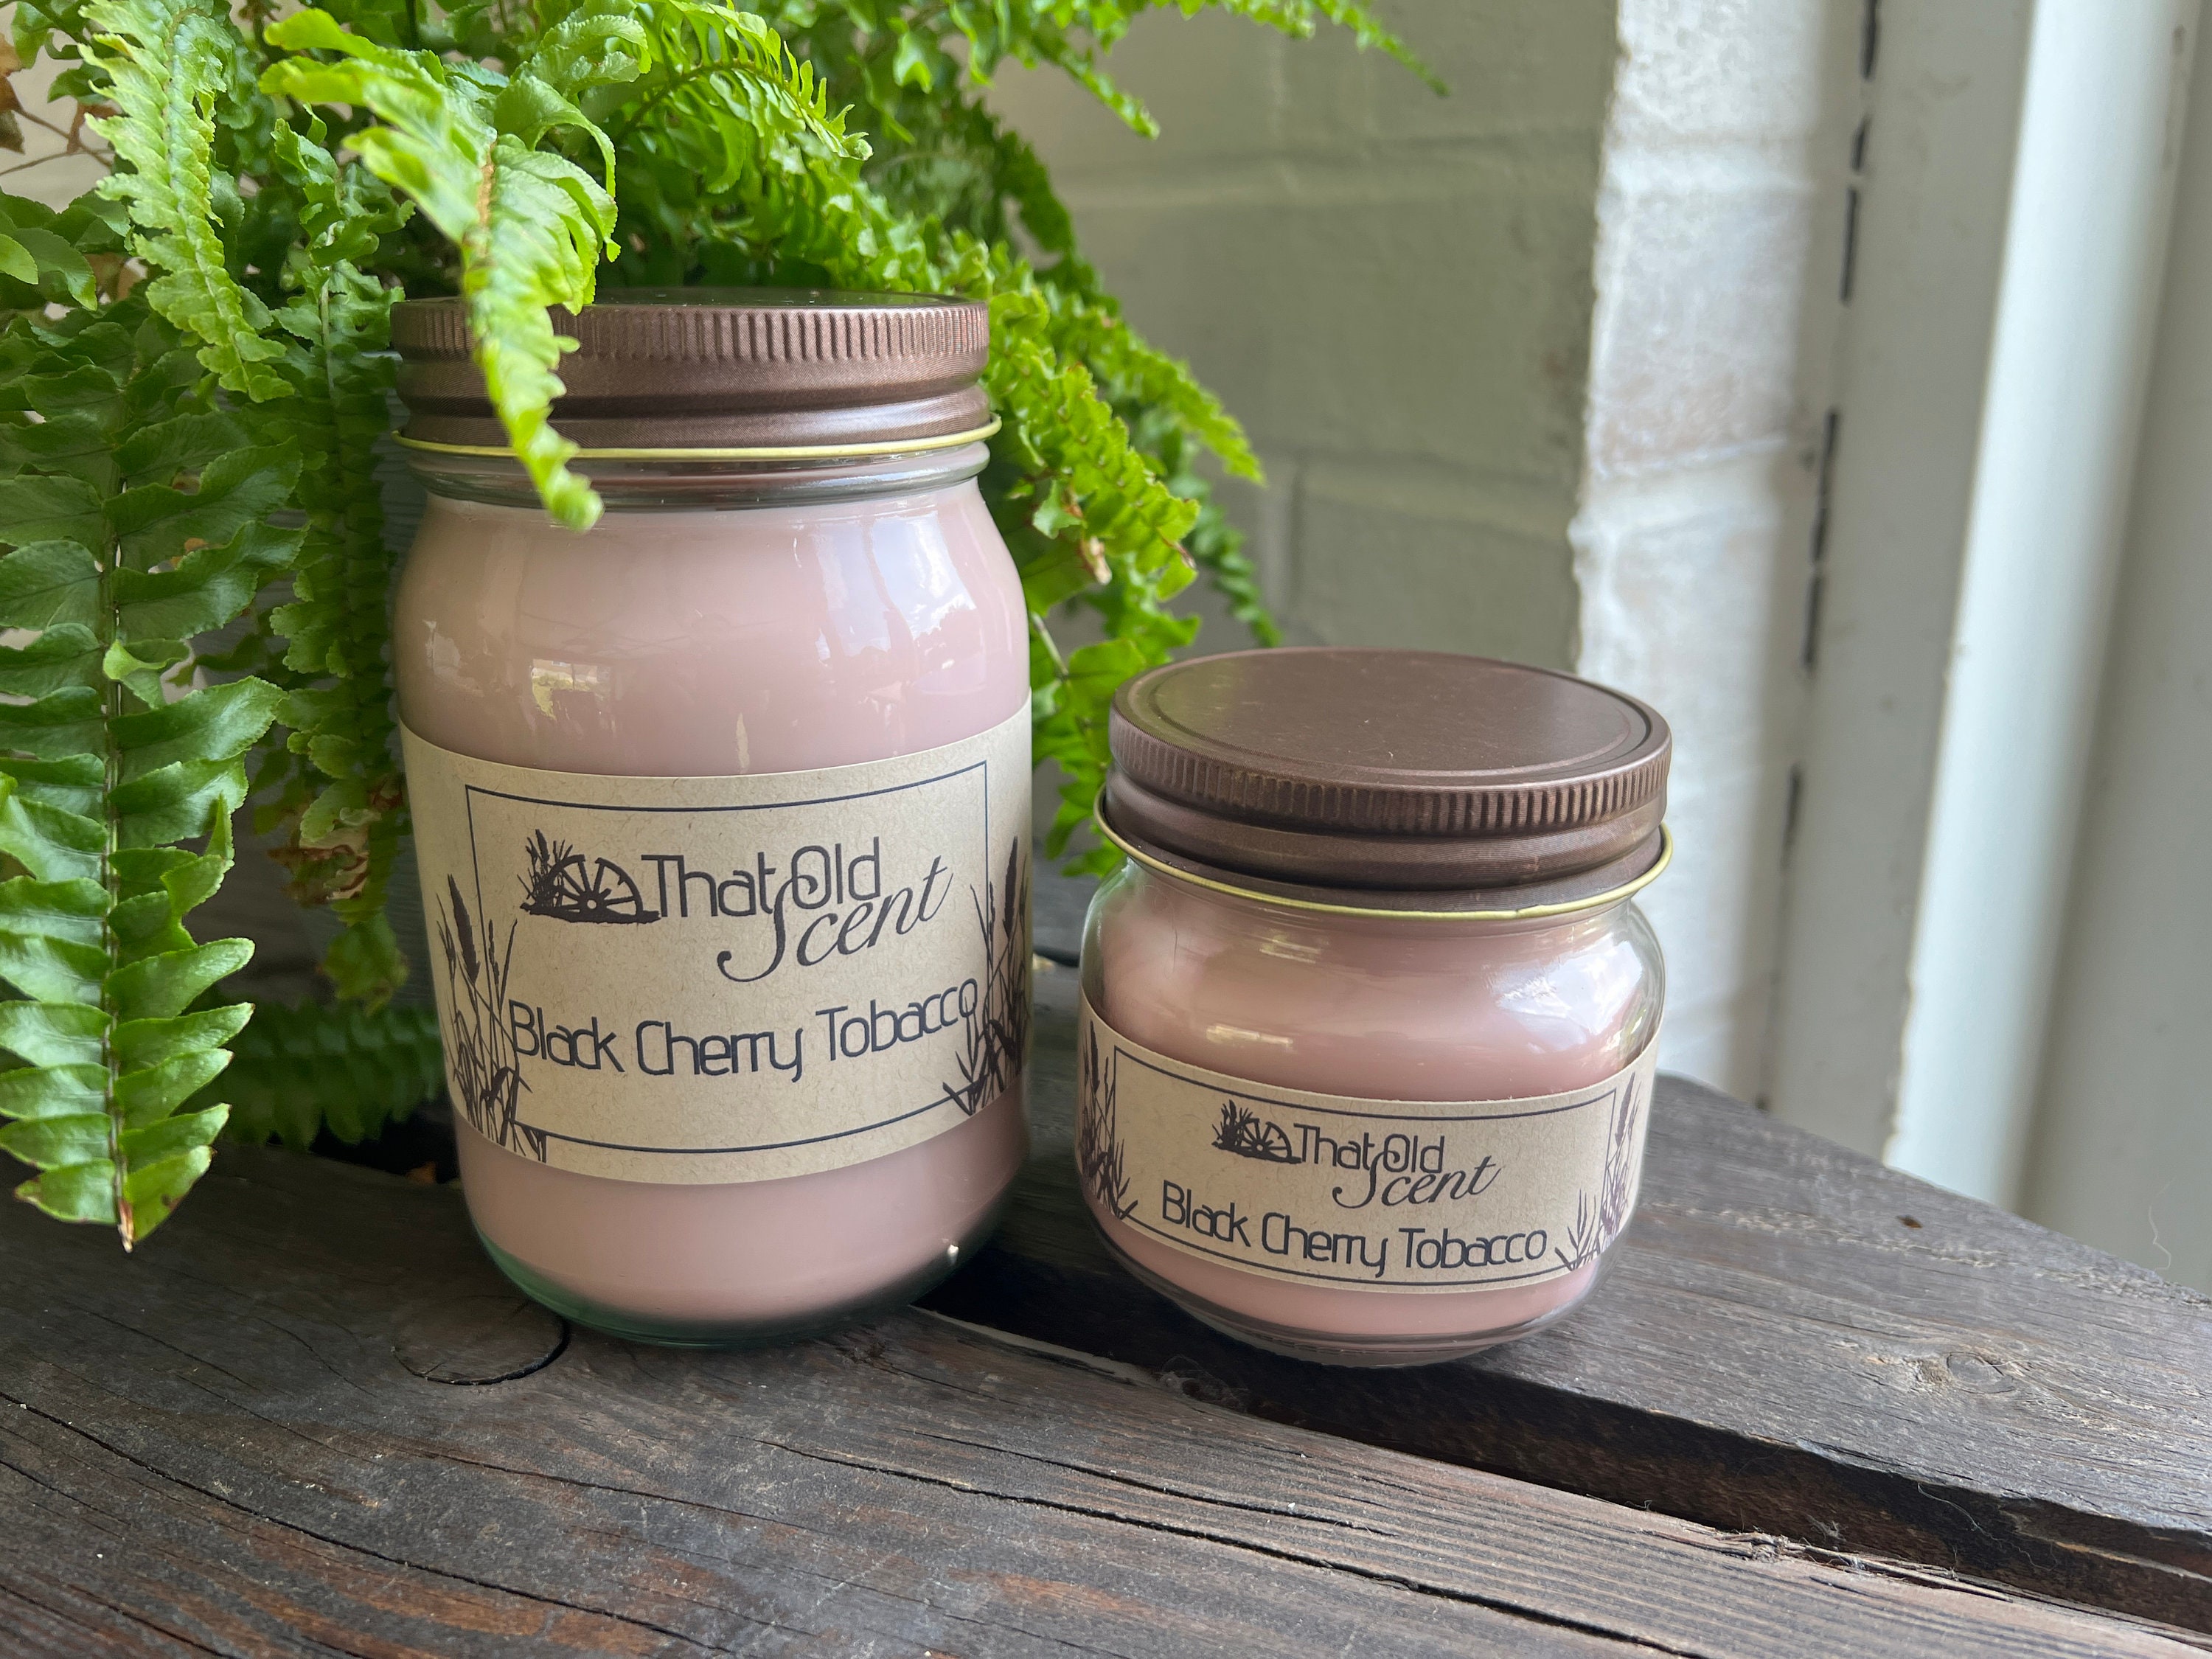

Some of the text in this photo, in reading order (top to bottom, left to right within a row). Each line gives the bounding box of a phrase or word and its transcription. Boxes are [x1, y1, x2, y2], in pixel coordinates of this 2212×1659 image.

[641, 836, 881, 918] That Old
[716, 855, 954, 983] Scent
[508, 978, 978, 1083] Black Cherry Tobacco
[1293, 1123, 1445, 1175] That Old
[1332, 1150, 1502, 1208] Scent
[1162, 1180, 1548, 1278] Black Cherry Tobacco
